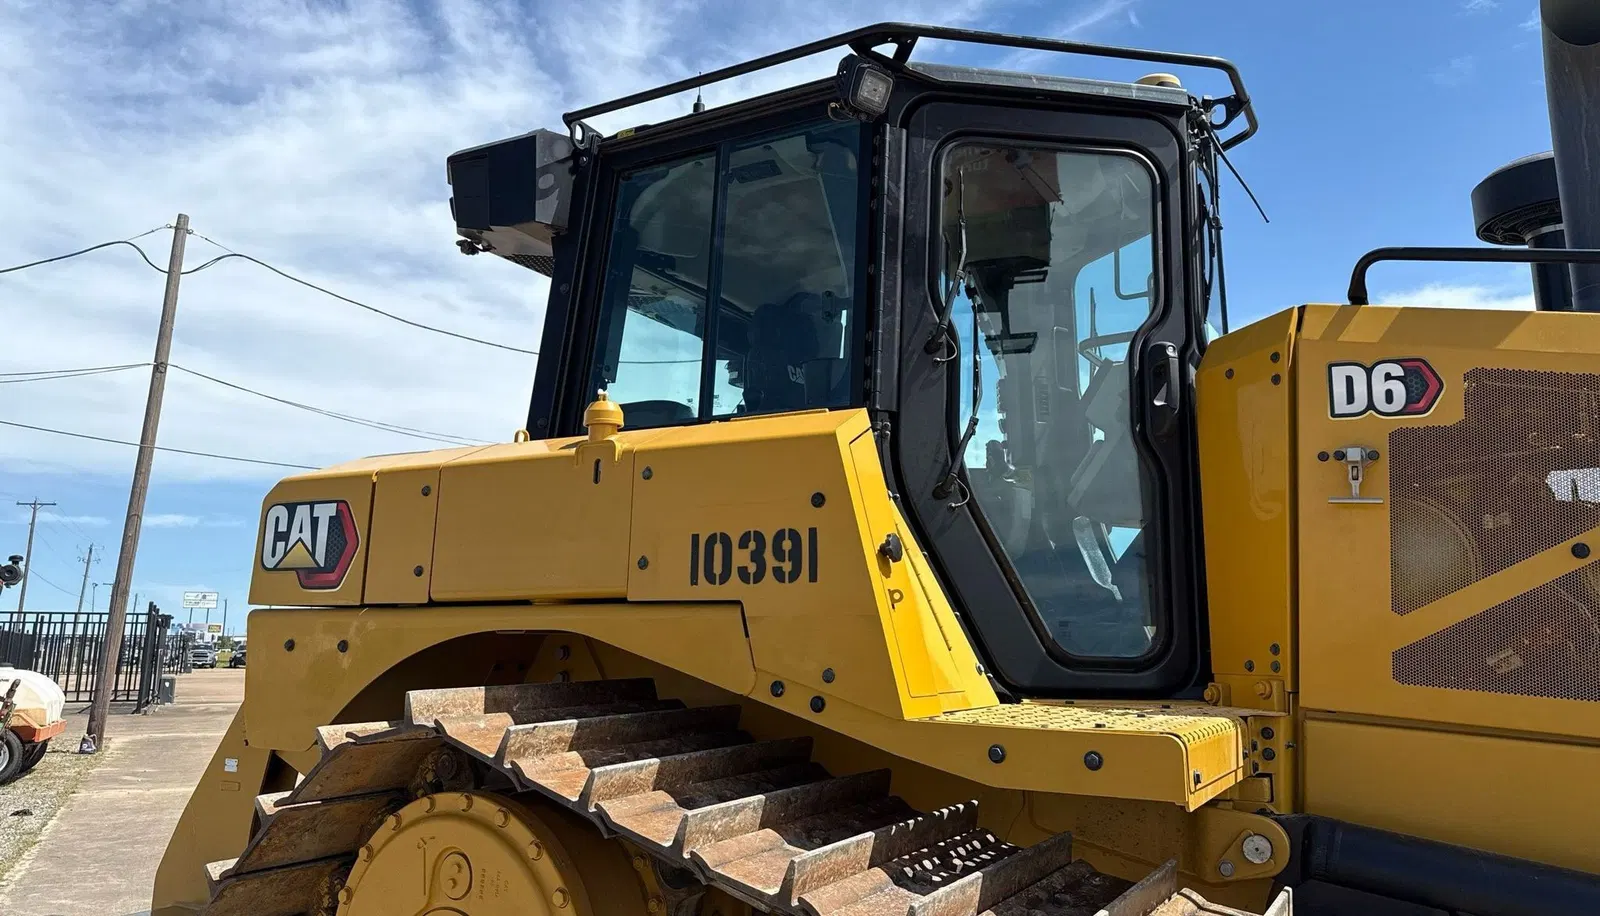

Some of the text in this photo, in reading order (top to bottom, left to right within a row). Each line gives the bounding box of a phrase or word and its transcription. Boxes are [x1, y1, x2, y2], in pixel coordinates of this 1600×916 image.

[787, 365, 805, 384] CA
[1331, 362, 1407, 414] D6
[262, 502, 338, 569] CAT
[690, 527, 818, 586] 10391
